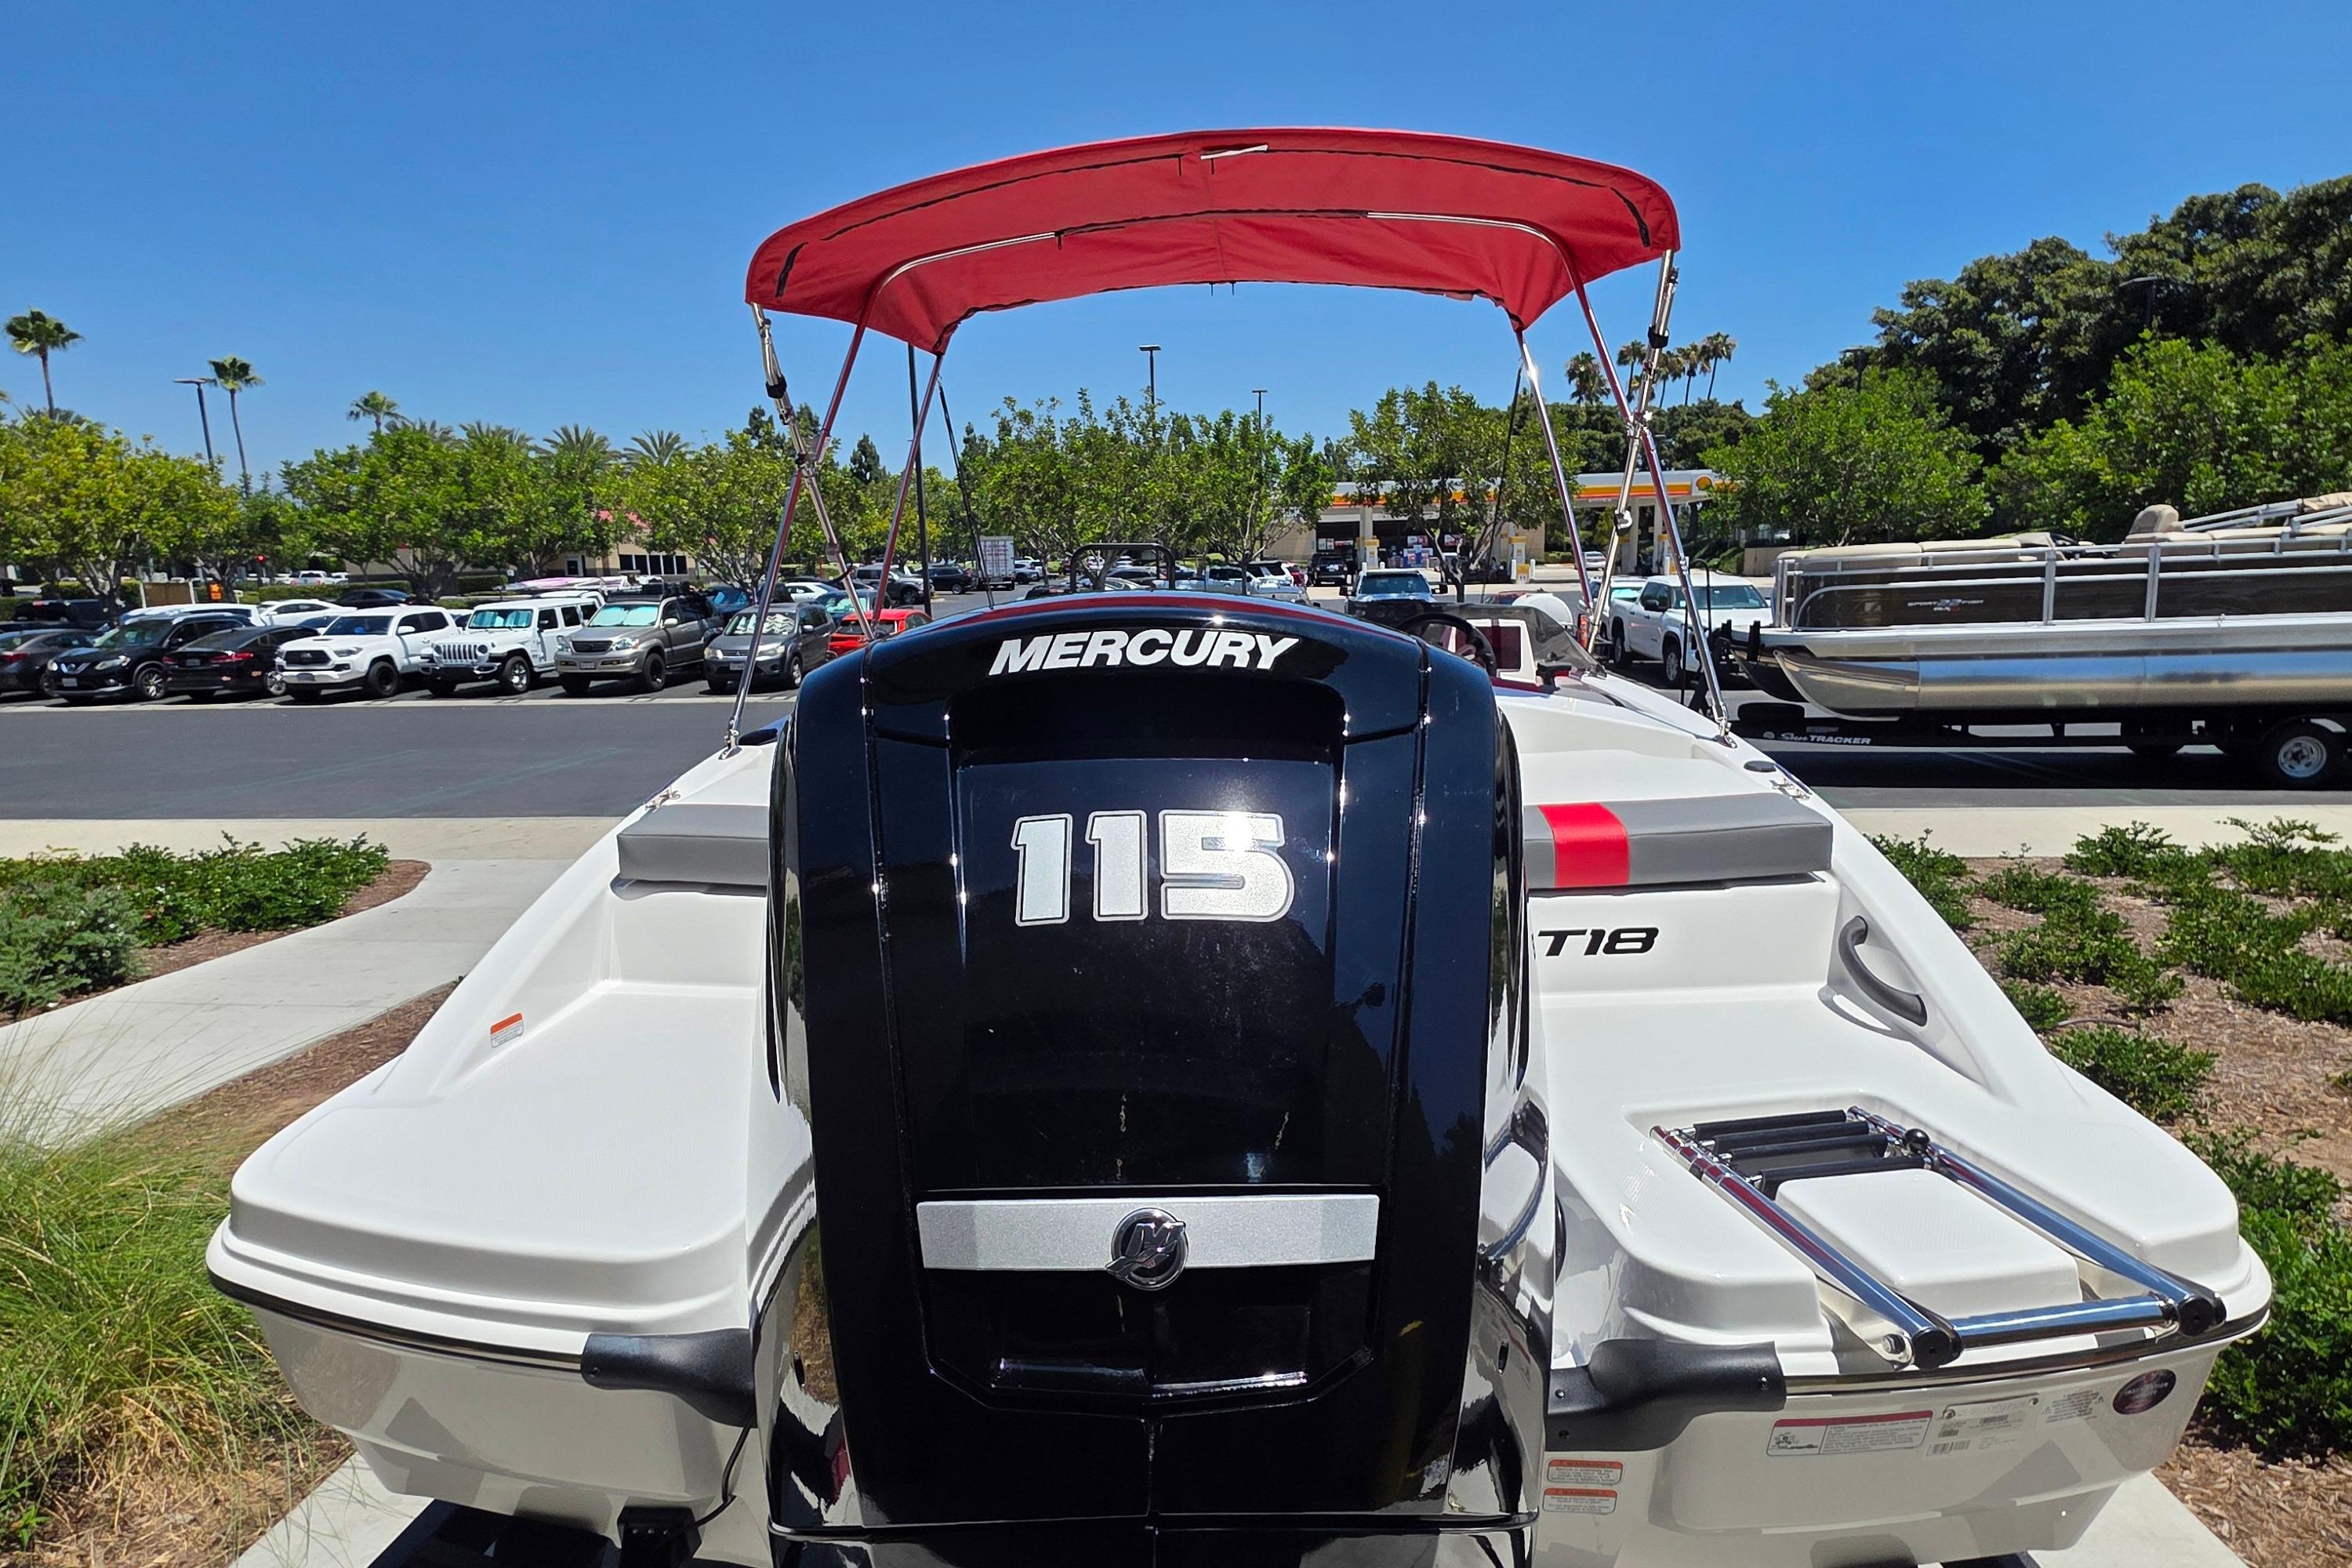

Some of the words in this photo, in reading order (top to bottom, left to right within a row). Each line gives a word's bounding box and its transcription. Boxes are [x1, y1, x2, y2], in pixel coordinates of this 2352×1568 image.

[988, 629, 1300, 676] MERCURY
[1809, 735, 1871, 745] TRACKER
[1011, 808, 1295, 927] 115
[1537, 927, 1660, 956] T18
